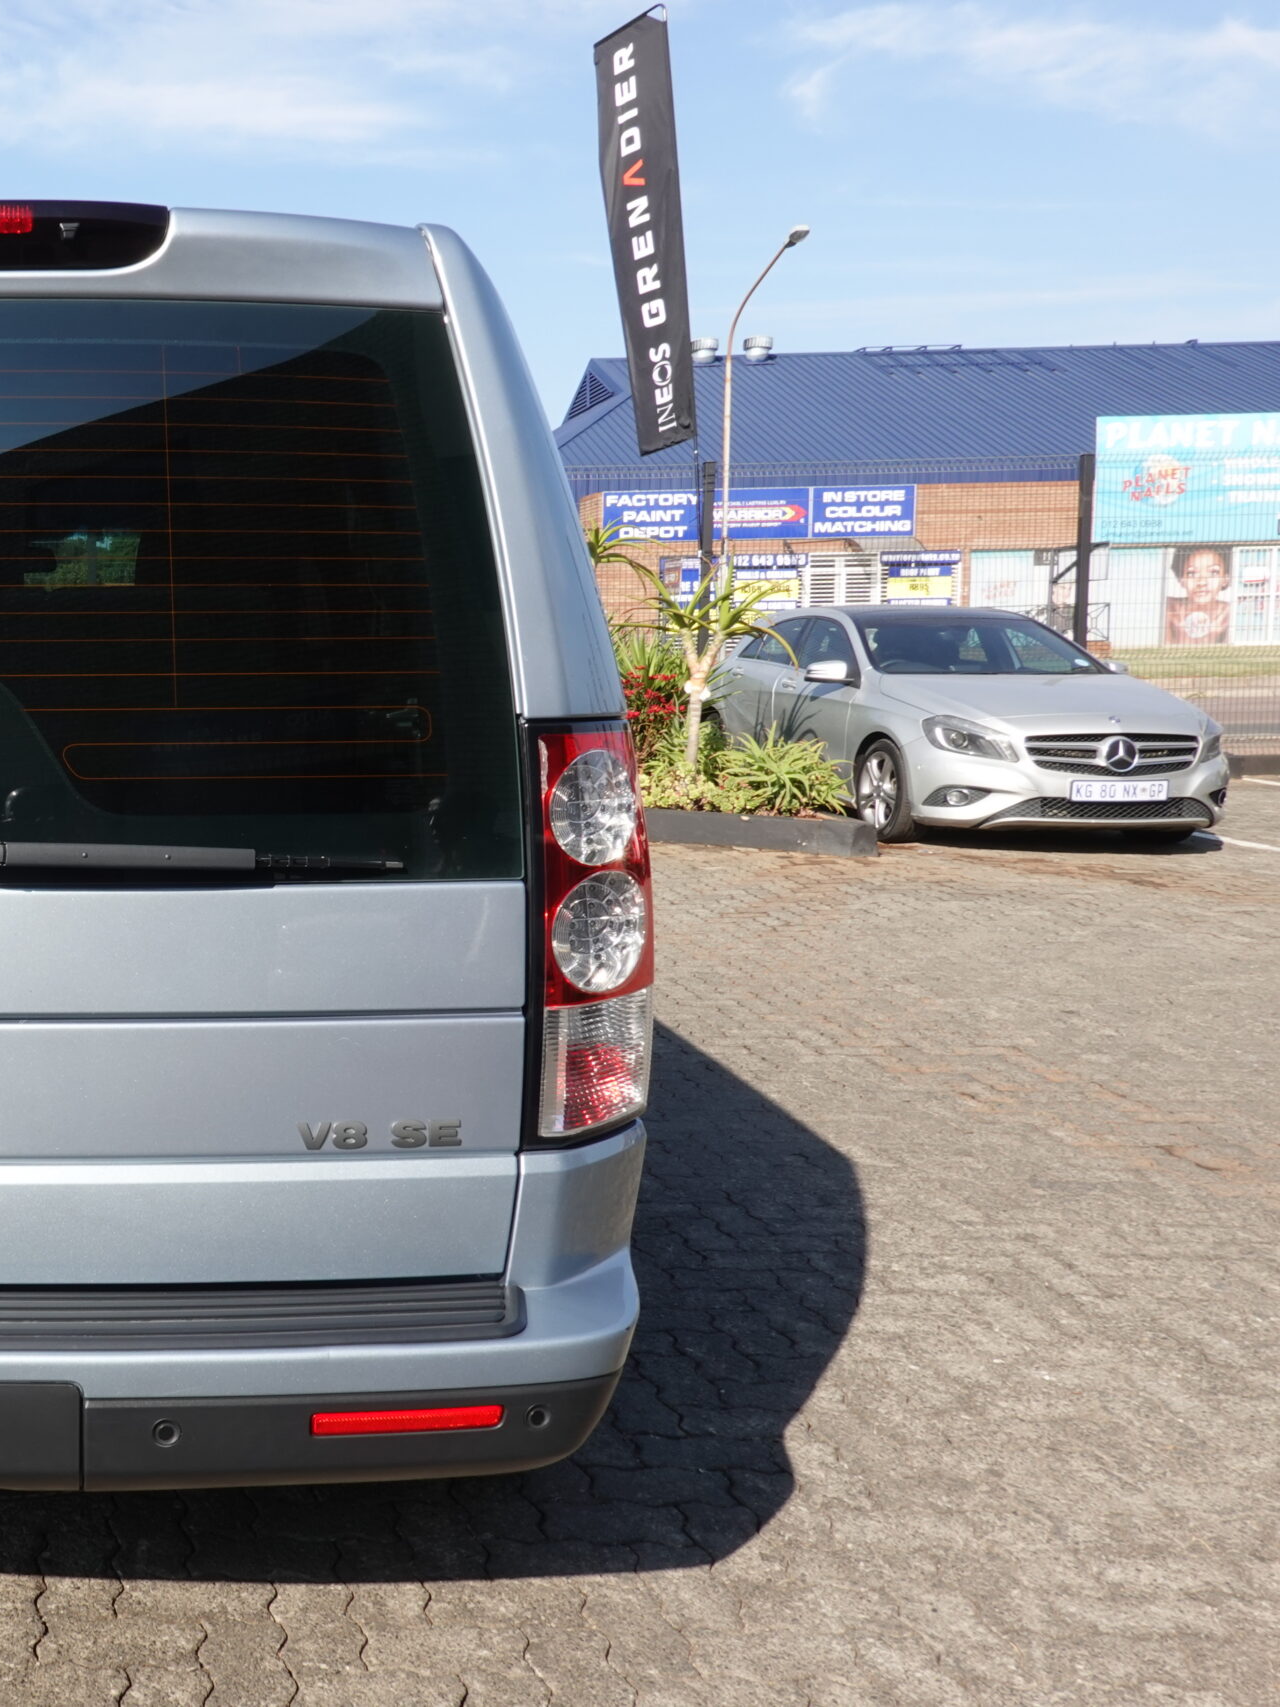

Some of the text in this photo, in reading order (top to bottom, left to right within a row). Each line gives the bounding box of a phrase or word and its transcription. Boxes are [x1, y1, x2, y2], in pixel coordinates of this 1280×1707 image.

[613, 41, 668, 328] GRENADIER
[649, 341, 677, 433] INEOS
[1105, 420, 1241, 449] PLANET
[1123, 467, 1192, 493] PLANET
[823, 490, 905, 503] IN STORE
[1130, 482, 1186, 502] NAILS
[606, 493, 697, 507] FACTORY
[623, 510, 684, 523] PAINT
[713, 509, 782, 521] WARRIOR
[825, 505, 902, 518] COLOUR
[619, 526, 688, 539] DEPOT
[814, 520, 911, 533] MATCHING
[1075, 784, 1092, 798] KG
[1123, 784, 1138, 798] NX
[1149, 783, 1164, 798] GP
[296, 1119, 462, 1150] V8 SE
